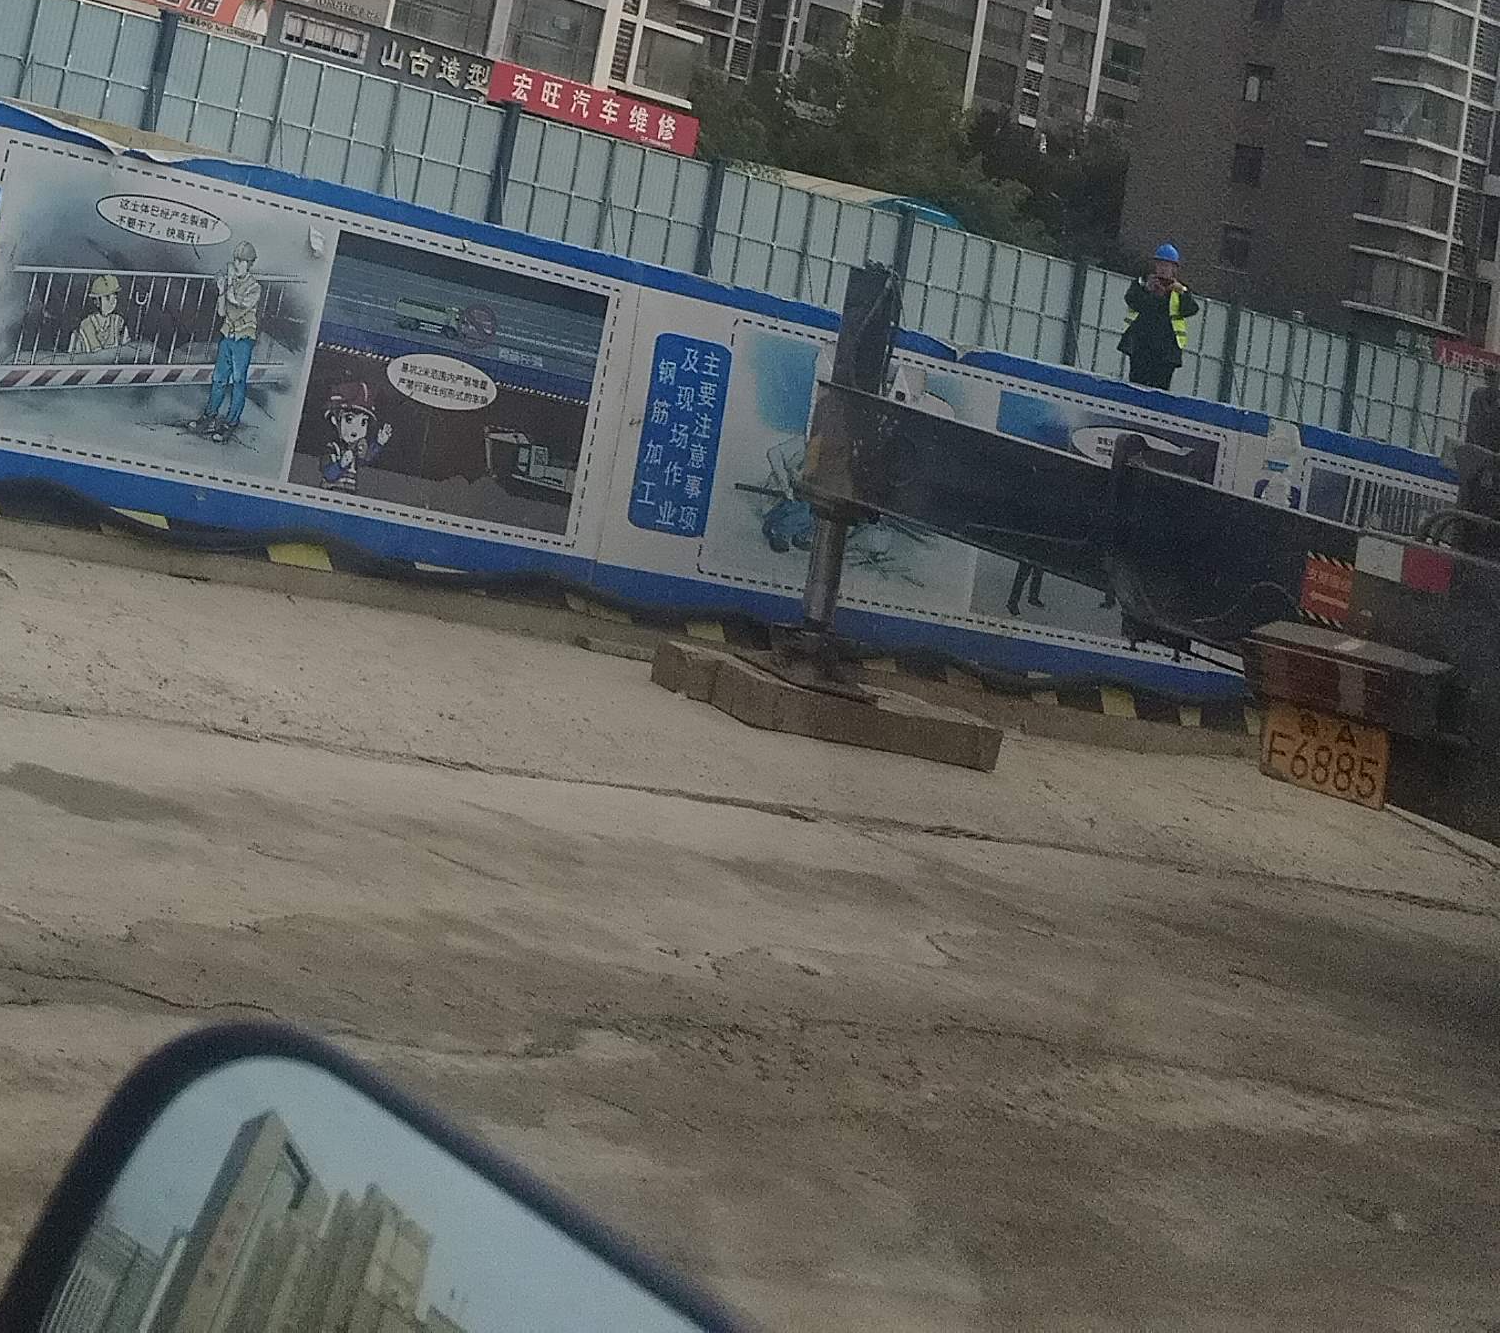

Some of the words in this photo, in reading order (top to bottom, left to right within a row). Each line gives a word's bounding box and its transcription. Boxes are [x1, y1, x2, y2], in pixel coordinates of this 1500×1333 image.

[379, 38, 492, 96] 山古造型
[511, 72, 677, 142] 宏旺汽车维修
[637, 358, 677, 506] 钢筋加工
[655, 346, 700, 527] 及现场作业
[678, 350, 721, 532] 主要注意事项
[1267, 729, 1380, 799] F6885
